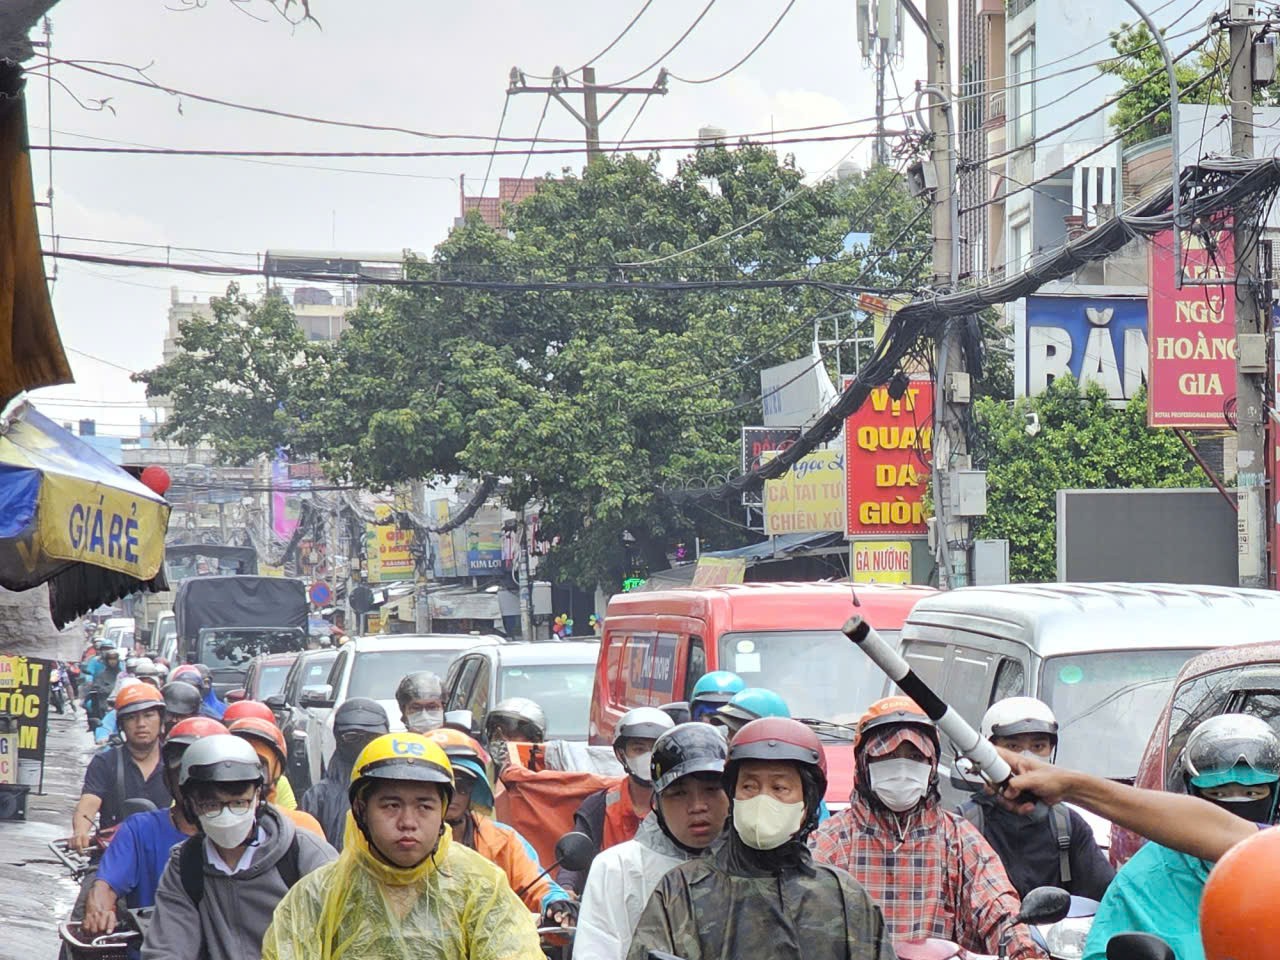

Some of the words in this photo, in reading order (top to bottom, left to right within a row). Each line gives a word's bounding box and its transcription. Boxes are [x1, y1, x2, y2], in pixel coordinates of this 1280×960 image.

[1175, 296, 1227, 323] NGỮ
[1178, 373, 1224, 396] GIA
[876, 464, 919, 488] DA
[69, 494, 105, 556] GIÁ
[108, 502, 139, 564] RẺ
[470, 559, 487, 569] KIM
[855, 546, 869, 571] GÀ
[872, 546, 910, 571] NƯỚNG
[392, 739, 425, 756] be
